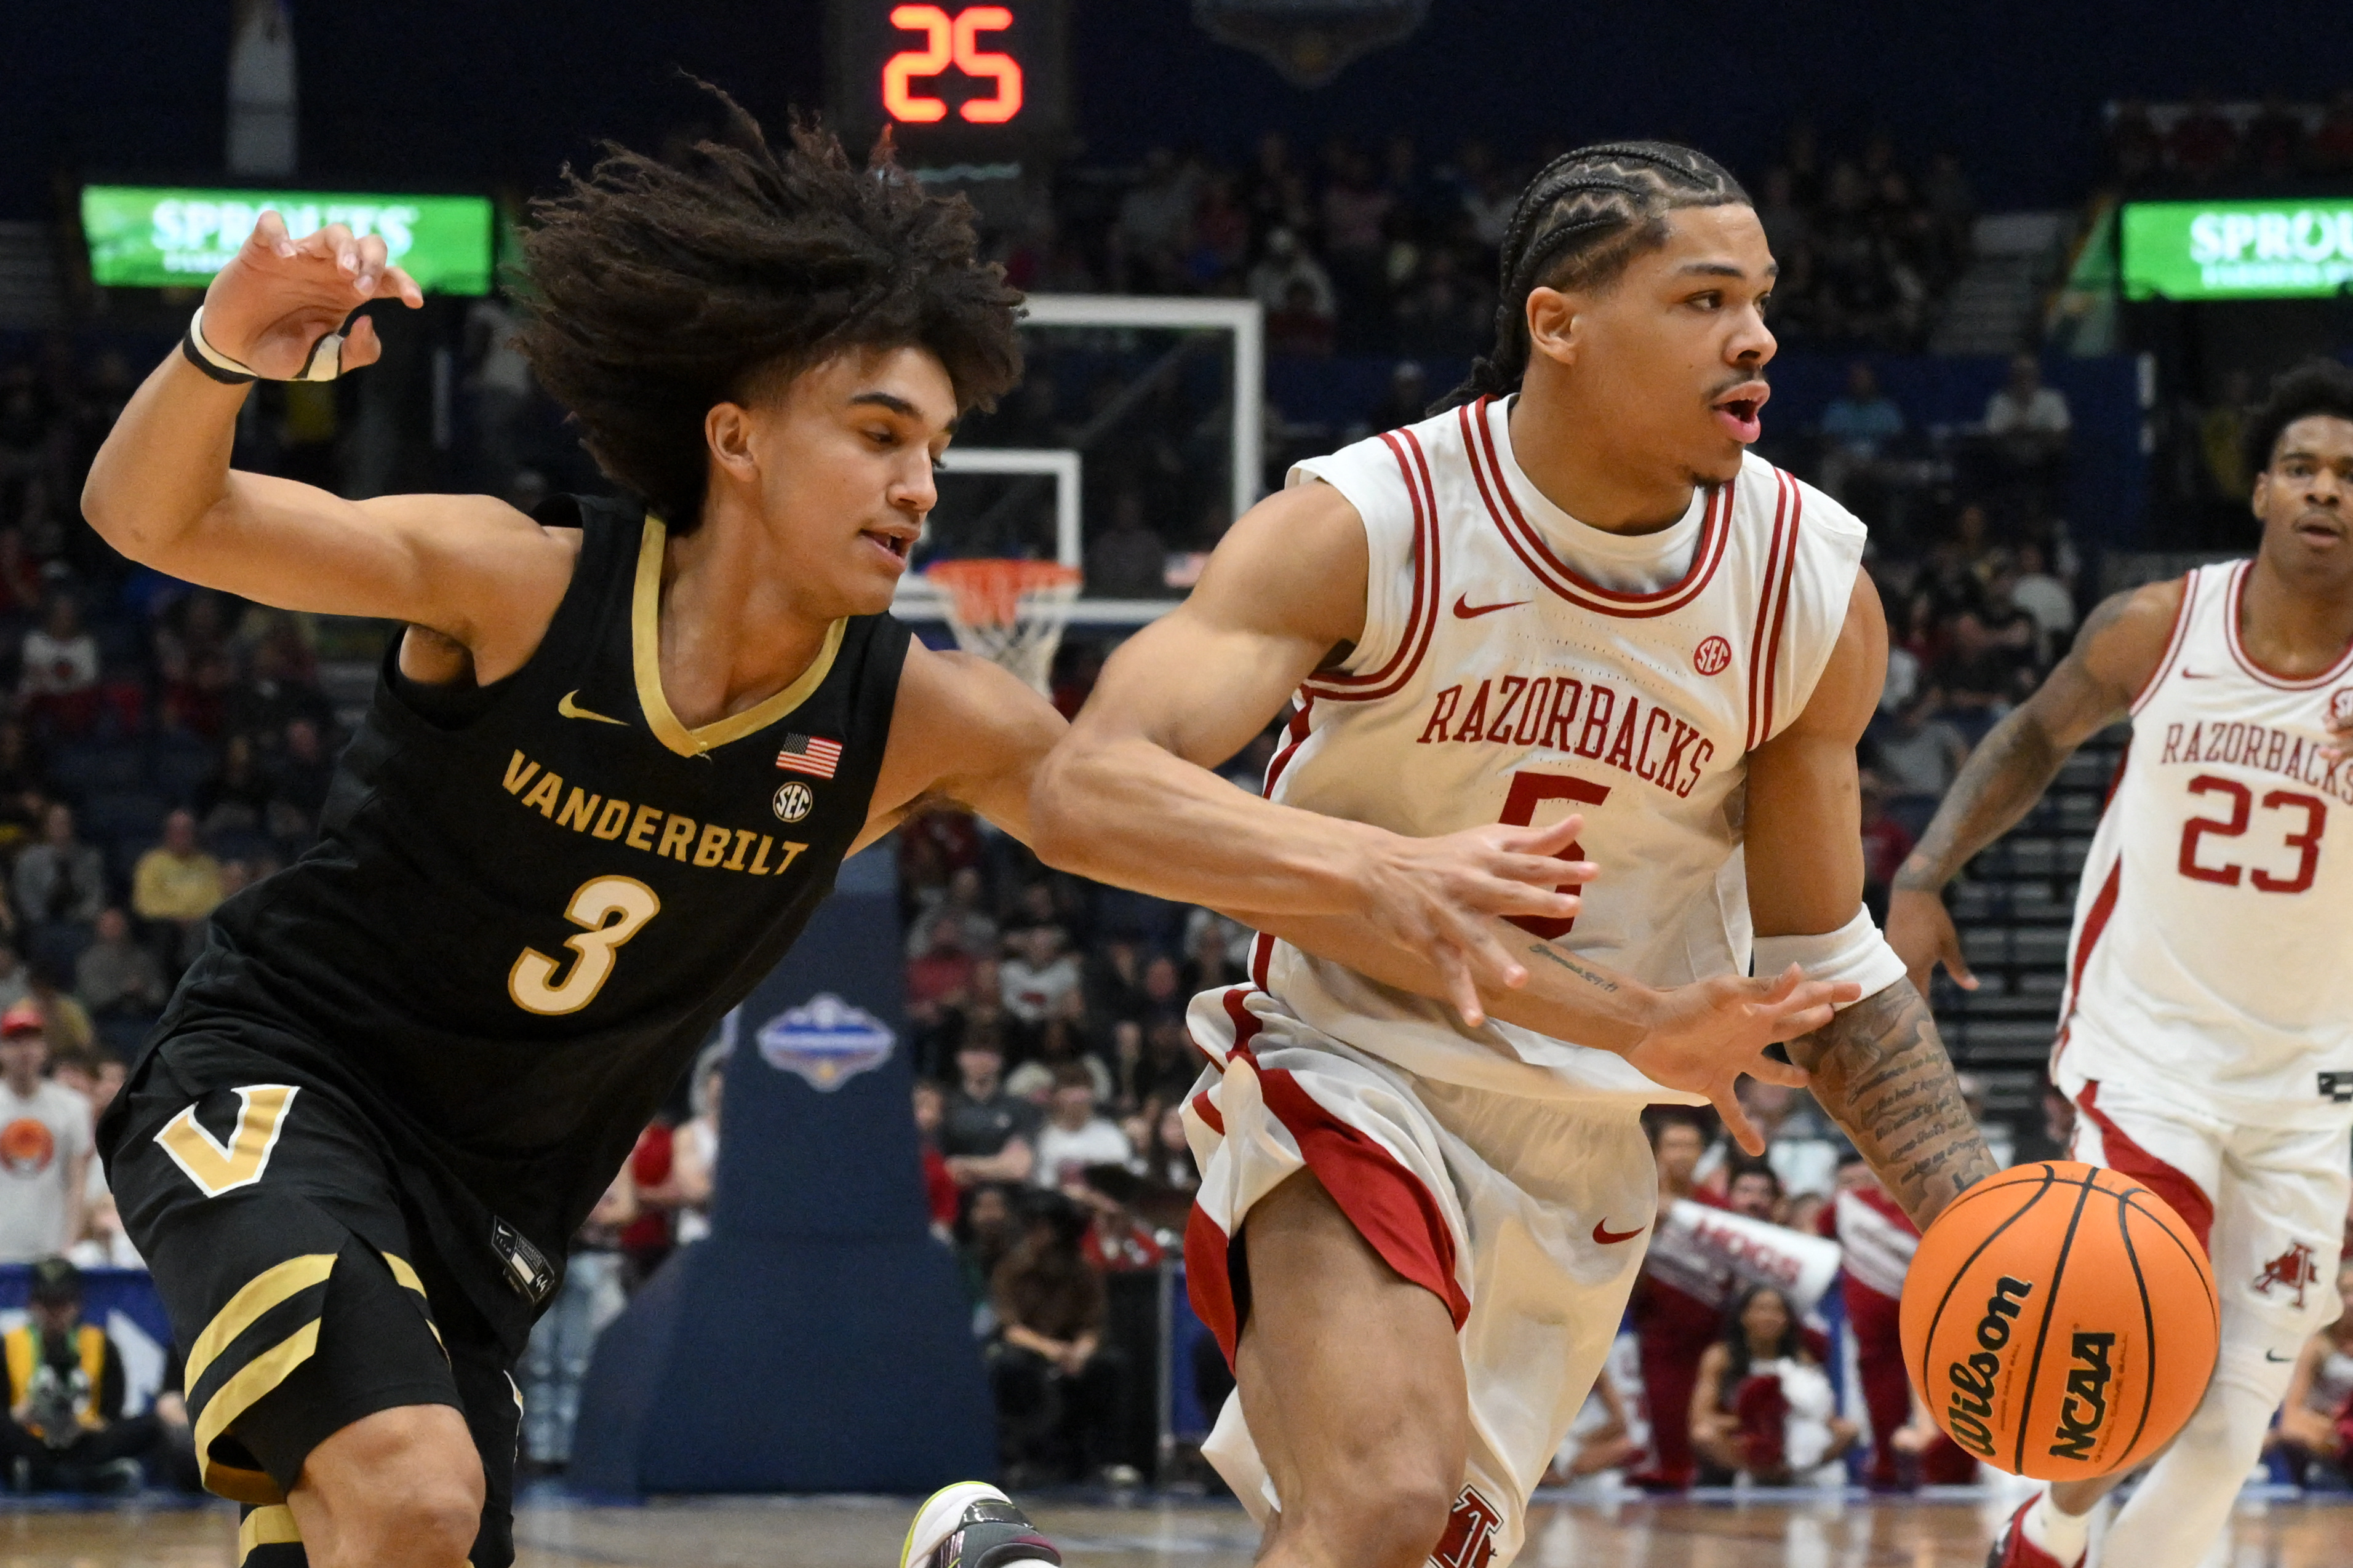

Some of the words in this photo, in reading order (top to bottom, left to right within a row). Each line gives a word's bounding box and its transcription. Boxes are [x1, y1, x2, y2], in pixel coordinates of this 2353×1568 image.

[882, 4, 1023, 123] 25
[1696, 638, 1730, 674] SEC
[1416, 676, 1716, 799] RAZORBACKS
[502, 749, 809, 876] VANDERBILT
[775, 784, 811, 821] SEC
[2179, 774, 2327, 893] 23
[508, 875, 660, 1015] 3
[153, 1084, 300, 1198] V
[536, 1273, 548, 1292] 44
[1948, 1275, 2033, 1457] Wilson
[2048, 1332, 2115, 1462] NCAA
